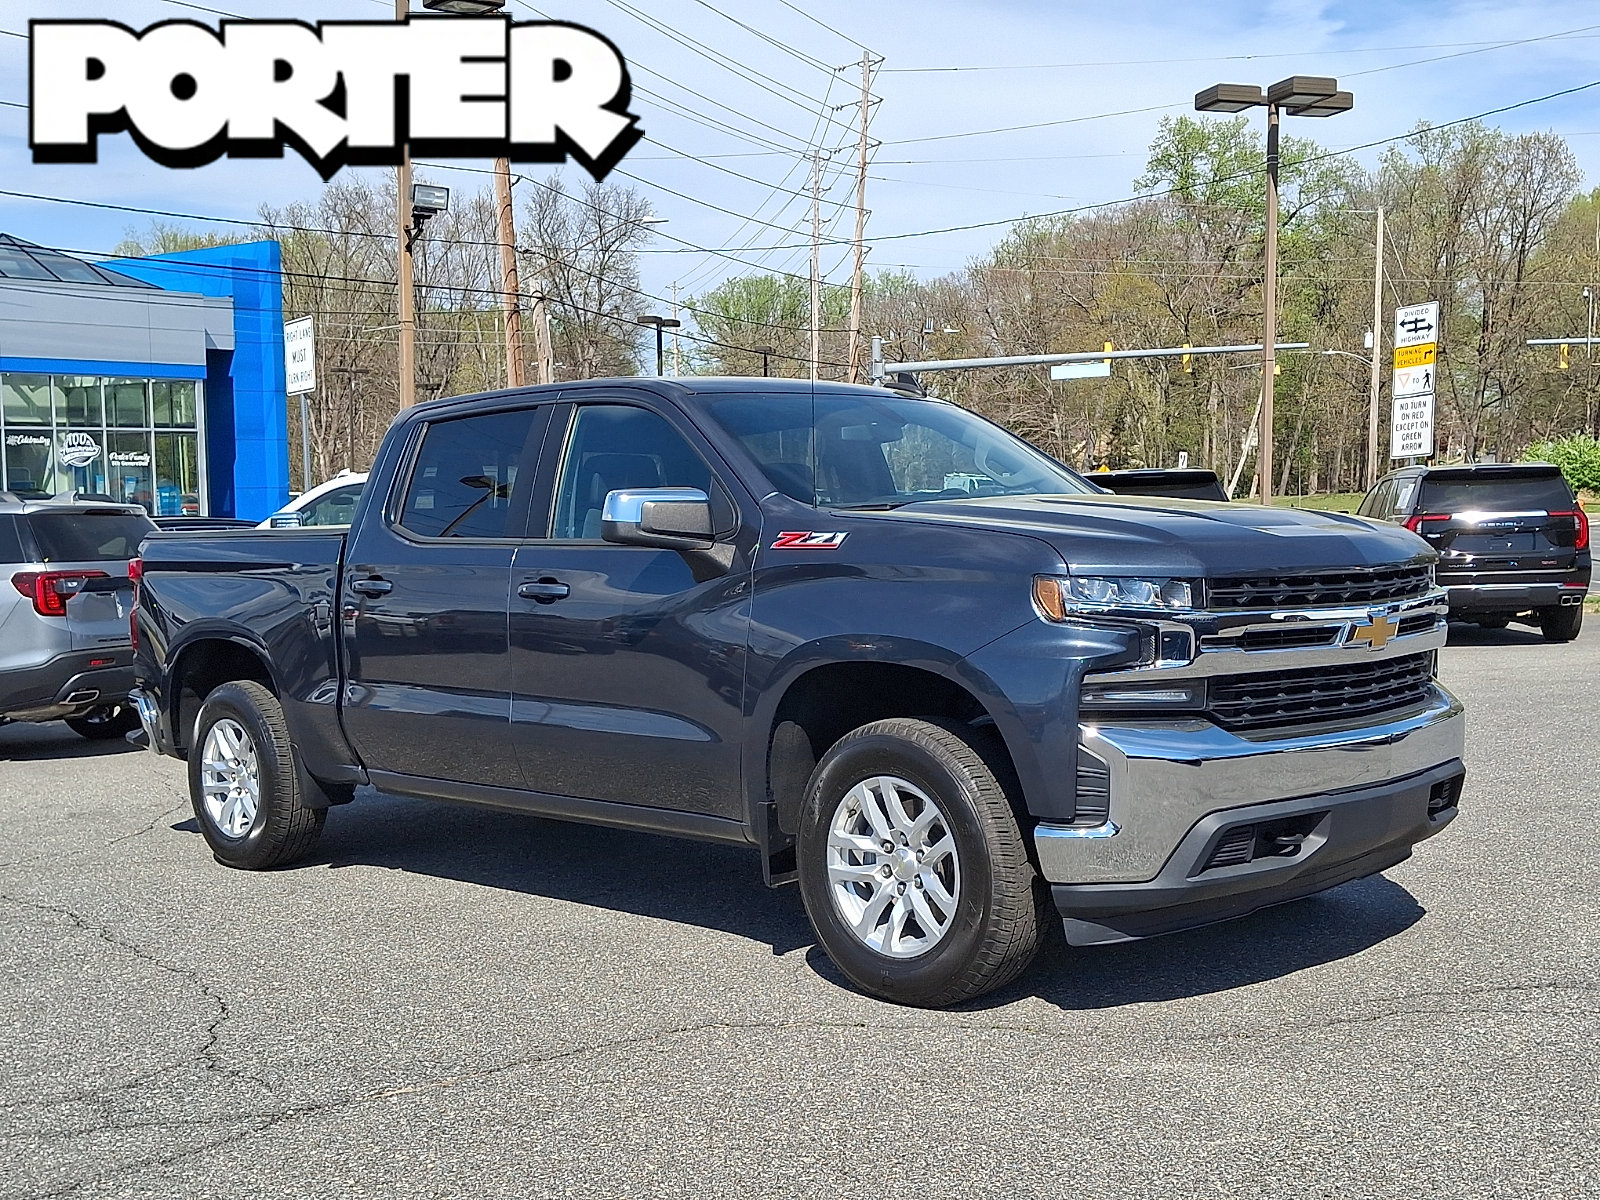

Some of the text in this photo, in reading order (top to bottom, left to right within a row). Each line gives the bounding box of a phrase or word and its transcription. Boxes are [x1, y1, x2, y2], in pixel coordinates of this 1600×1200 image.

[1404, 308, 1430, 317] DIVIDED
[286, 327, 311, 342] RIGHT LANE
[1401, 333, 1430, 343] HIGHWAY
[292, 348, 307, 364] MUST
[1398, 348, 1422, 357] TURNING
[1397, 358, 1422, 366] VEHICLES
[288, 369, 313, 385] TURN RIGHT
[1400, 401, 1427, 411] NO TURN
[1401, 410, 1425, 421] ON RED
[1395, 420, 1429, 431] EXCEPT ON
[1401, 431, 1422, 442] GREEN
[1401, 442, 1422, 451] ARROW
[769, 530, 851, 550] Z71
